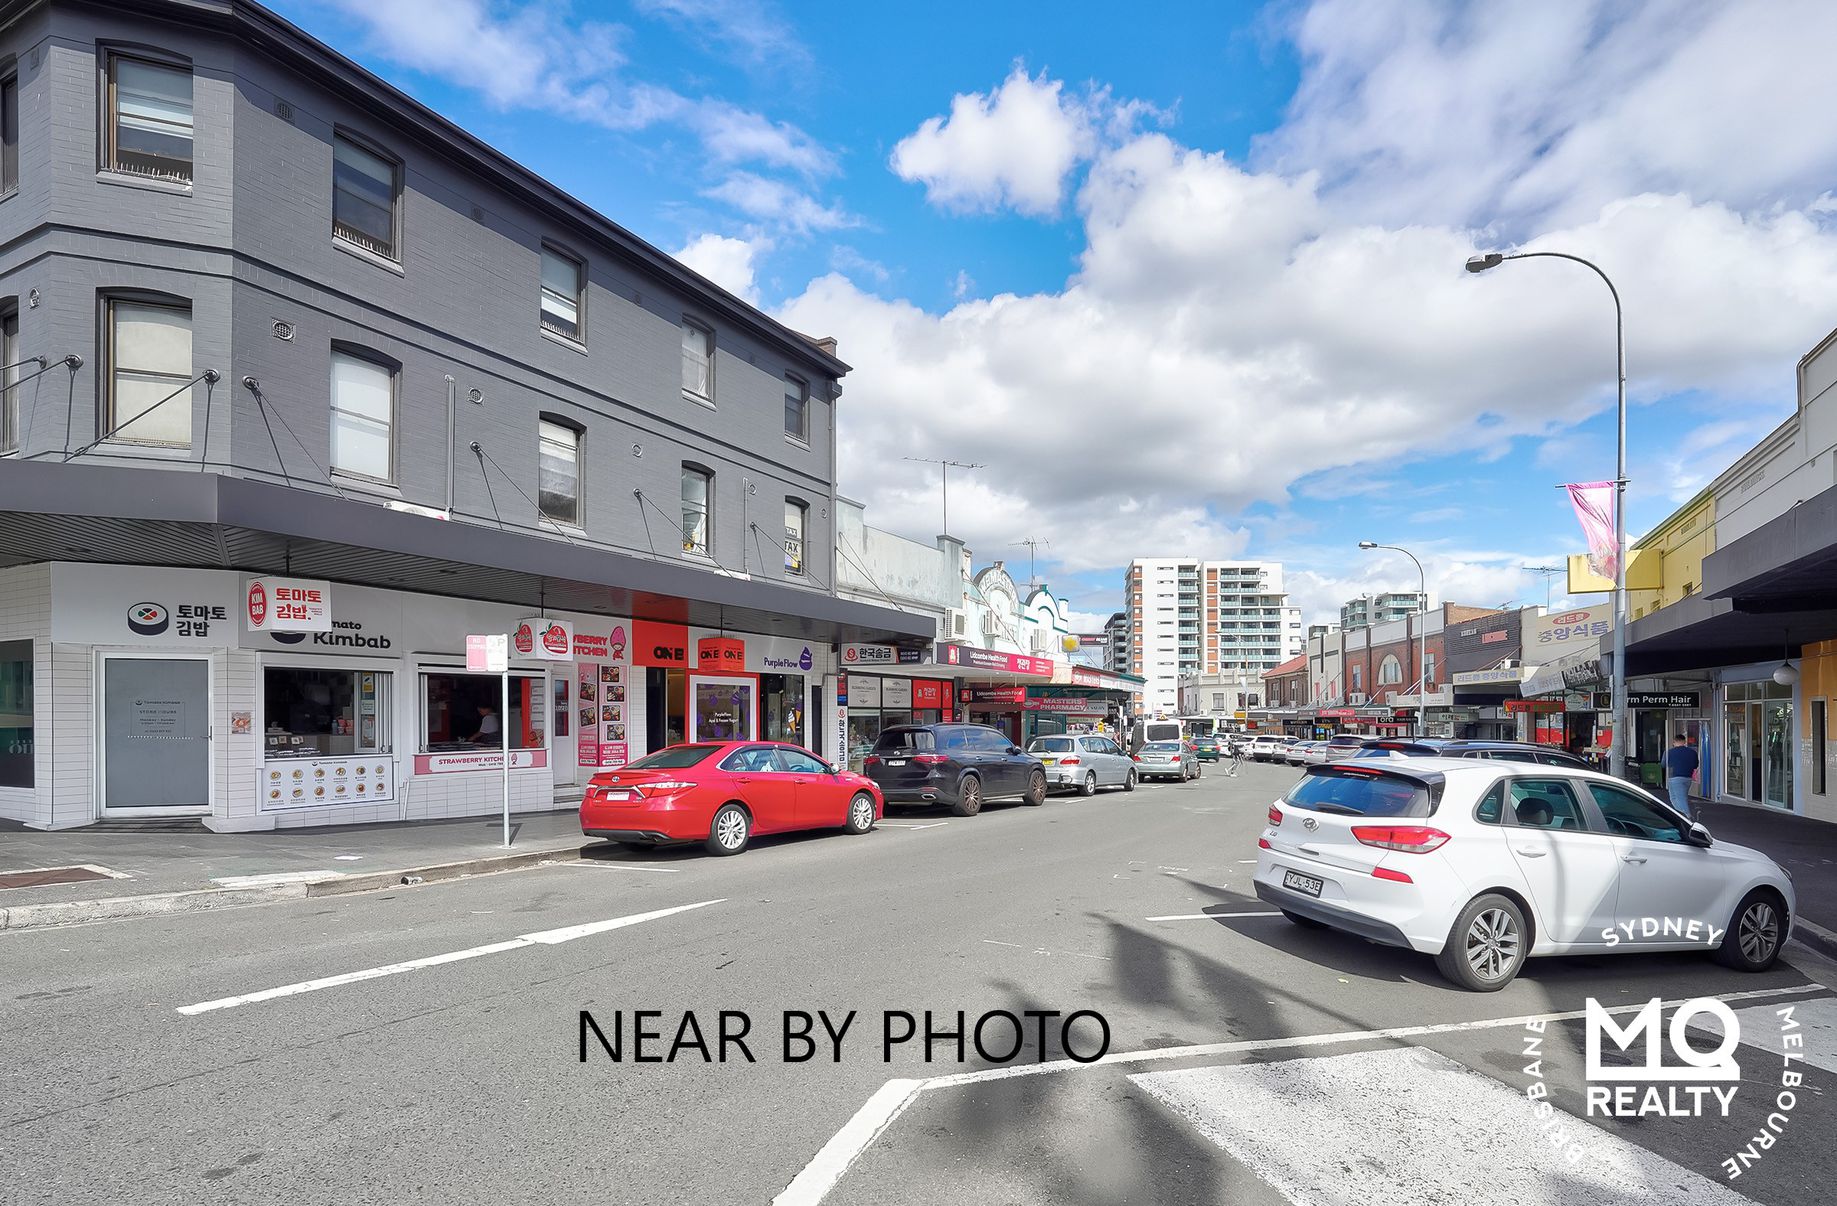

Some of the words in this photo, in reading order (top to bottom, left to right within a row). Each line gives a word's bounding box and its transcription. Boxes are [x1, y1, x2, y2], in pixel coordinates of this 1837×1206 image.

[786, 528, 797, 536] TAX
[785, 541, 798, 553] TAX
[251, 593, 264, 604] KIM
[276, 588, 322, 603] 토마토
[176, 604, 227, 621] 토마토
[252, 605, 264, 615] BAB
[176, 621, 210, 638] 김밥
[331, 620, 362, 630] mato
[1538, 620, 1610, 643] 중앙식품
[313, 631, 391, 649] Kimbab
[573, 646, 608, 657] ITCHEN
[653, 646, 684, 661] ONE
[701, 649, 719, 659] ONE
[724, 650, 743, 660] ONE
[859, 647, 892, 659] 한국송금
[1642, 695, 1668, 704] Perm
[1671, 695, 1692, 703] Hair
[838, 720, 846, 762] 한국송금
[438, 757, 483, 765] STRAWBERRY
[484, 755, 504, 763] KITCH
